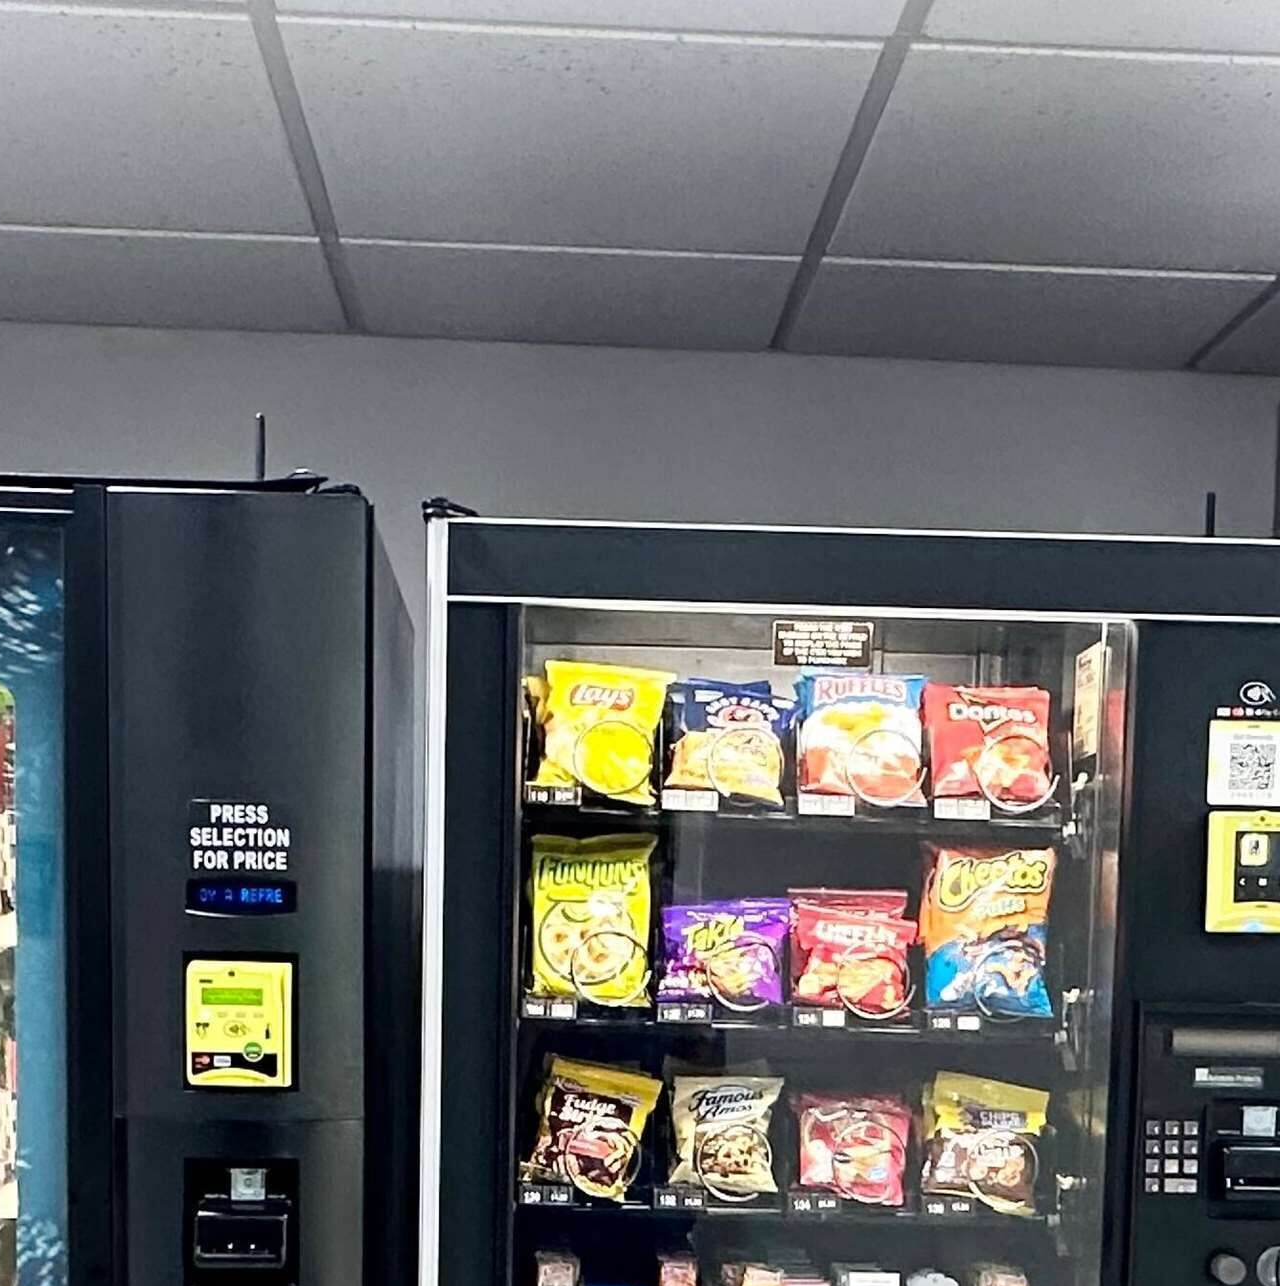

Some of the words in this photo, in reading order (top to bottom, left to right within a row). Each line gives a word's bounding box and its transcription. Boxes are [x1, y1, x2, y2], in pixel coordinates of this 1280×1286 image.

[818, 677, 905, 701] RUFFLES
[210, 804, 268, 824] PRESS
[190, 827, 290, 847] SELECTION
[193, 850, 229, 870] FOR
[233, 850, 287, 871] PRICE
[941, 853, 1048, 907] Cheetos
[563, 1093, 617, 1116] Fudge
[688, 1088, 765, 1112] Famous
[698, 1103, 752, 1122] Amos
